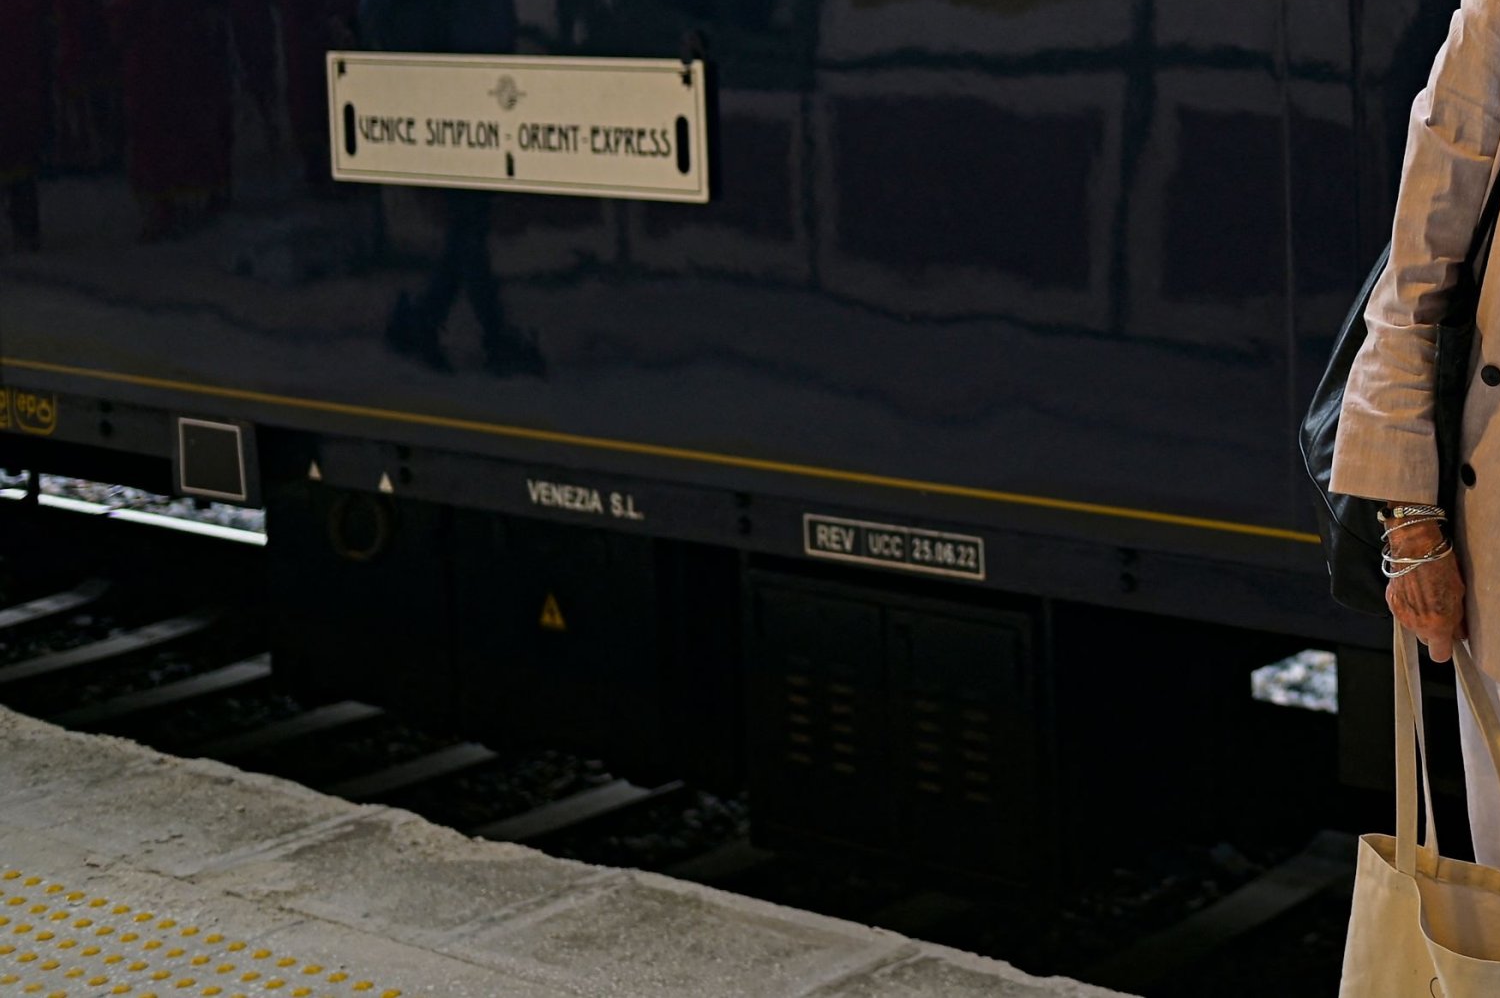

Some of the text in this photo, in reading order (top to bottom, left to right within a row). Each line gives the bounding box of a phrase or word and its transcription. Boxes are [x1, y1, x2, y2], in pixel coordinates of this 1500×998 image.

[358, 116, 416, 145] VENICE
[527, 479, 604, 514] VENEZIA
[816, 524, 855, 553] REV
[867, 532, 904, 558] UCC
